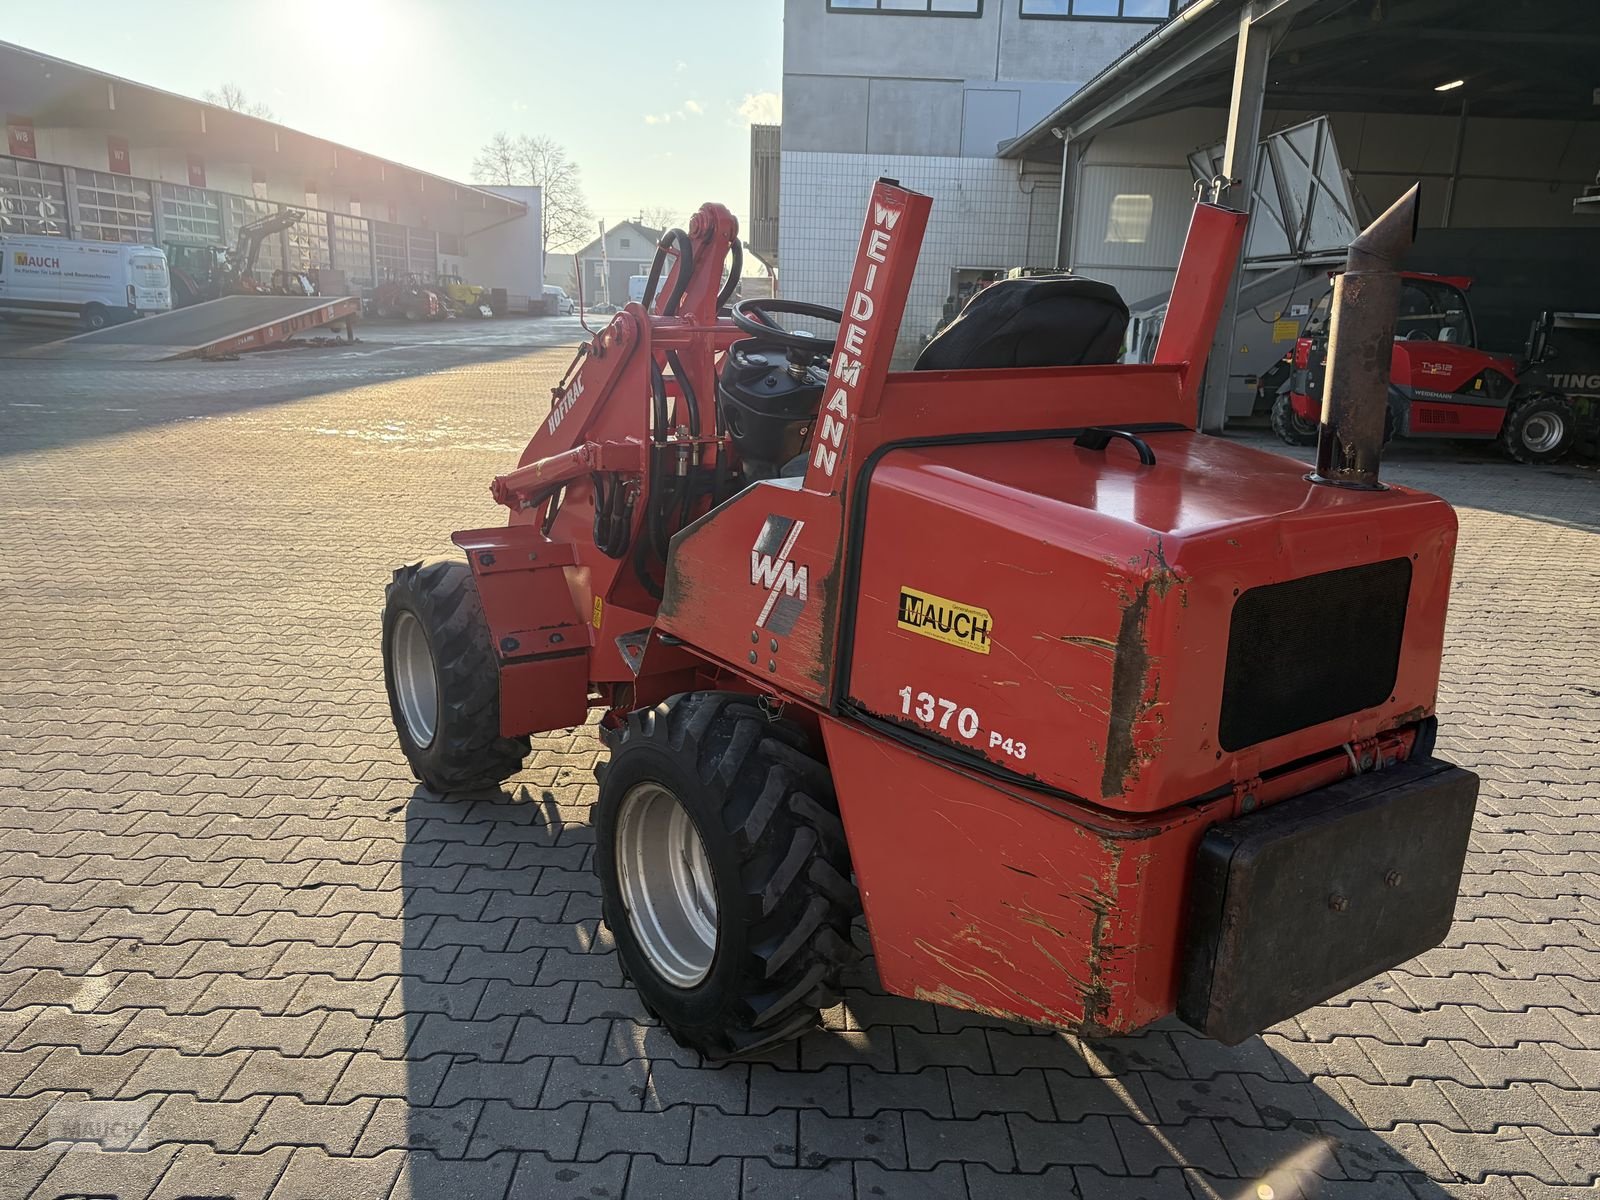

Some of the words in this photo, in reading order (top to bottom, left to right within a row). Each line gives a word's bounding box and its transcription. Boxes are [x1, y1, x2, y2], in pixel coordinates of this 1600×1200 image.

[15, 129, 28, 143] W8
[114, 151, 124, 161] W7
[17, 255, 60, 268] MAUCH
[75, 272, 111, 280] Baumaschinen
[814, 200, 902, 477] WEIDEMANN
[1415, 389, 1453, 400] WEIDEMANN
[547, 370, 585, 436] HOFTRAC
[904, 595, 989, 645] MAUCH
[899, 685, 980, 739] 1370
[989, 730, 1027, 760] P43
